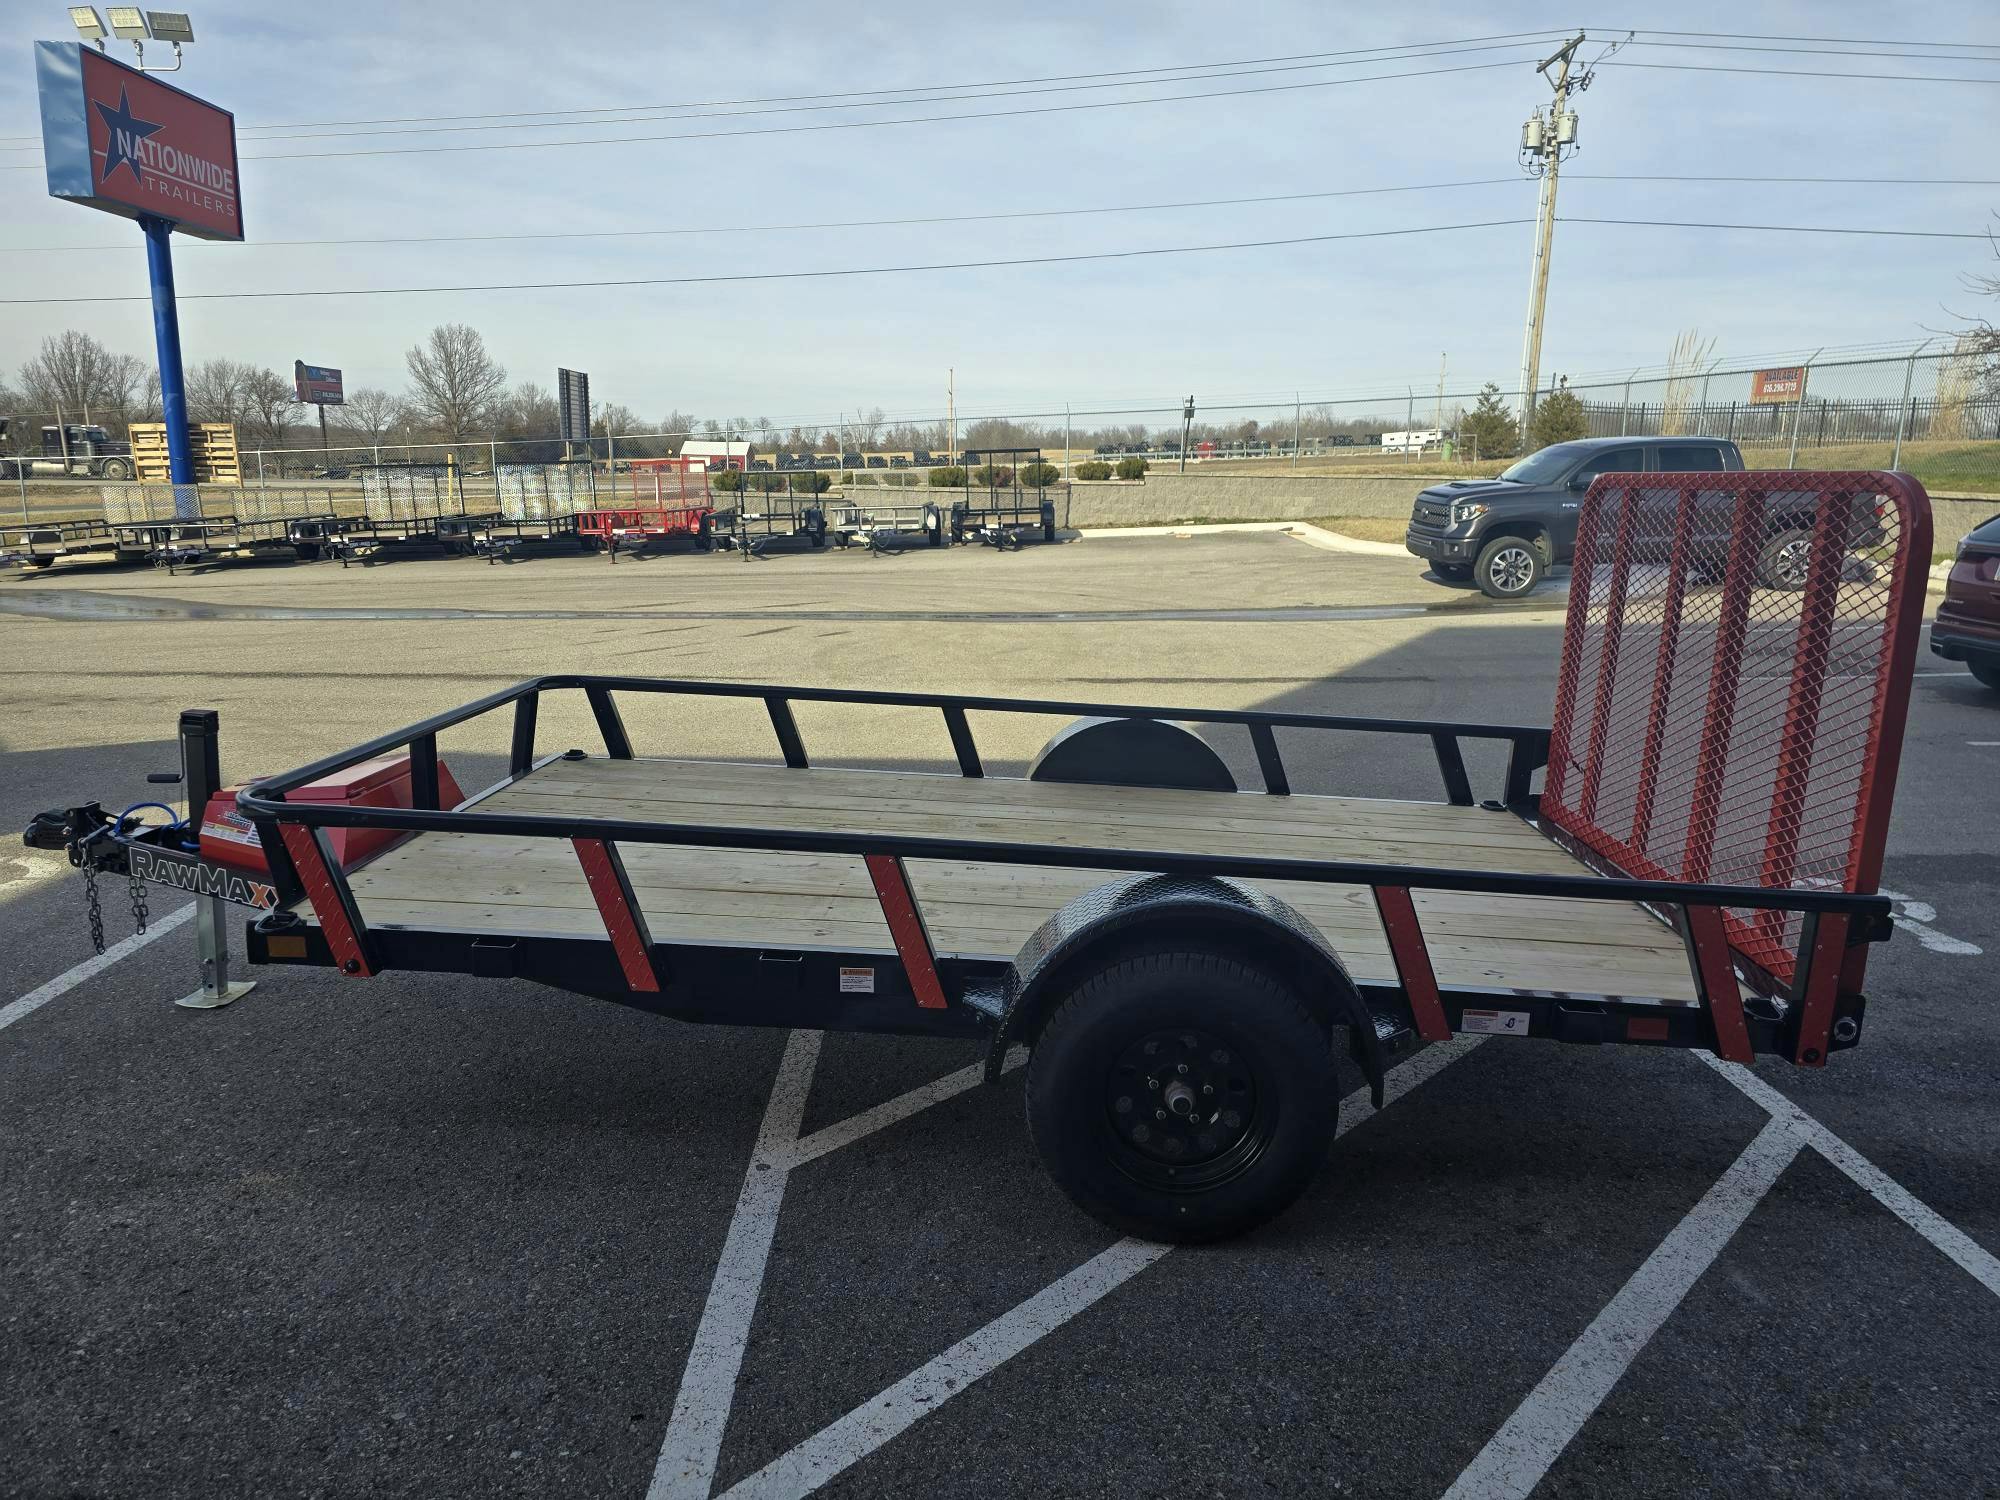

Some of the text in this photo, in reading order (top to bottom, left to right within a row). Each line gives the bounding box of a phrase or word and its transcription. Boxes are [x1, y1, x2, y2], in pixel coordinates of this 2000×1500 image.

[116, 127, 234, 194] NATIONWIDE
[144, 176, 235, 217] TRAILERS
[1764, 368, 1799, 382] AVAILABLE
